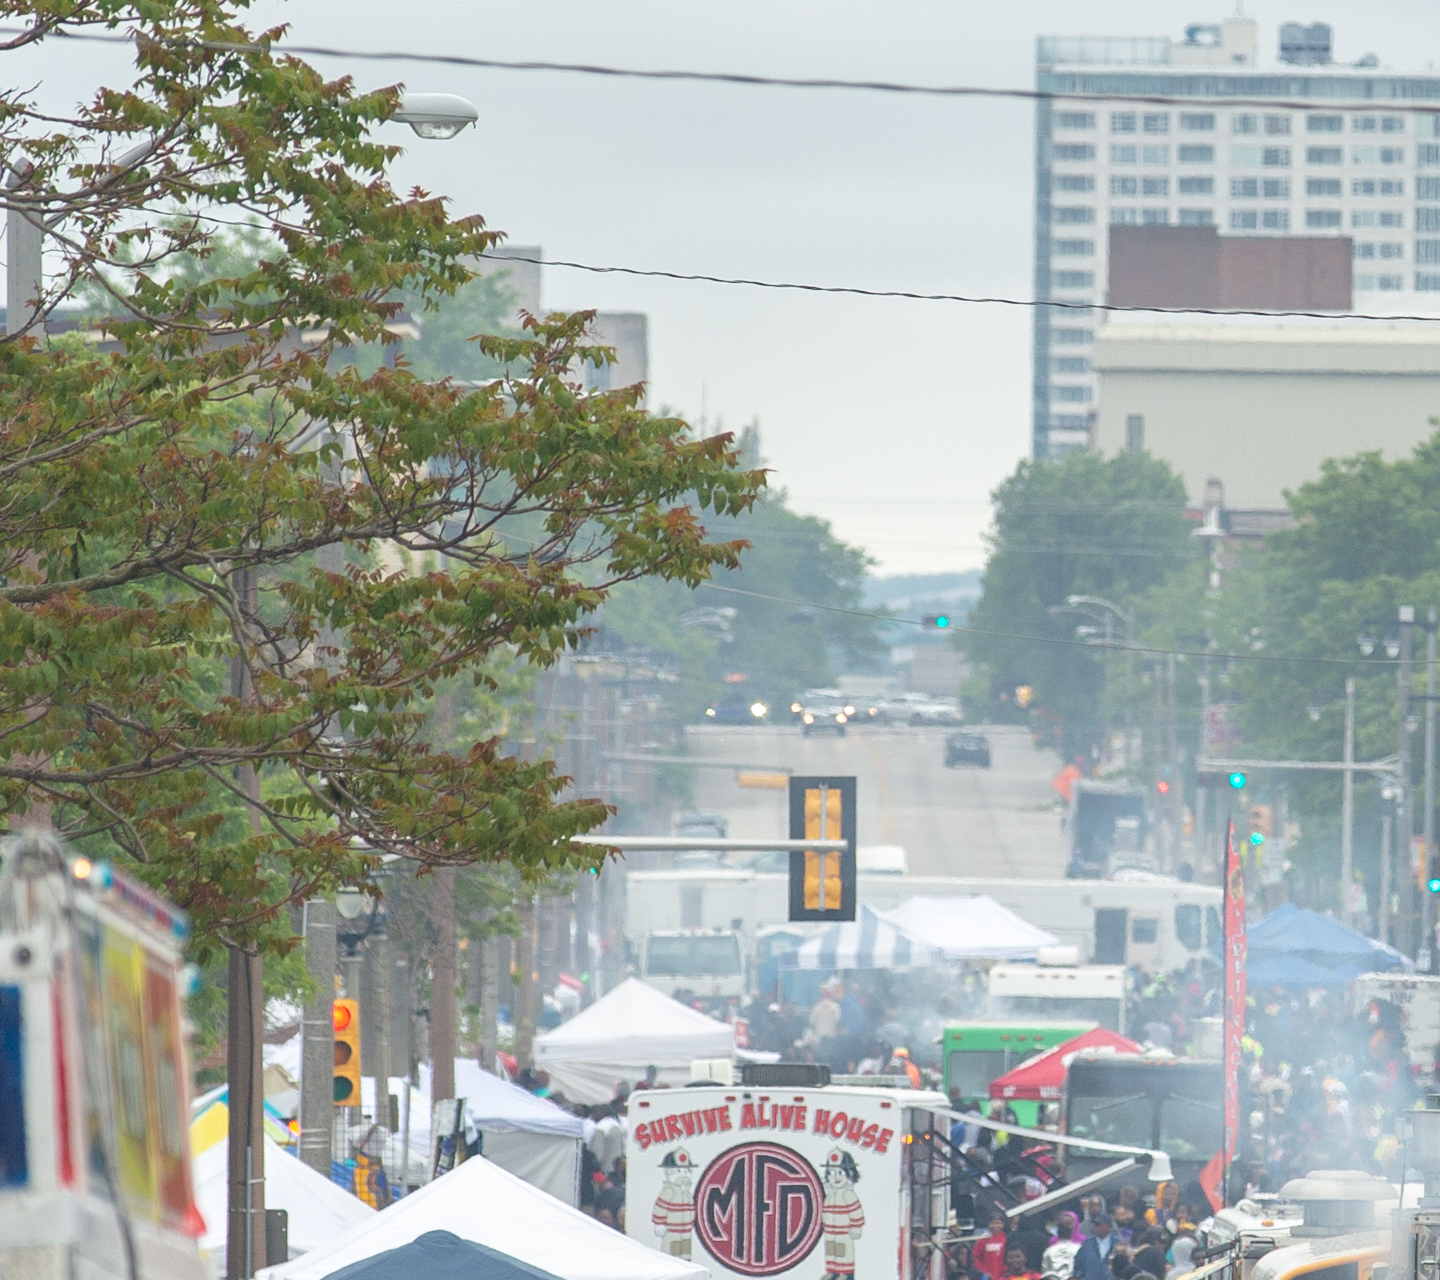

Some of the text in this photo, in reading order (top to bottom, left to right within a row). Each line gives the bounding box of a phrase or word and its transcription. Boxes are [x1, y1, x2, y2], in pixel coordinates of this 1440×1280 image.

[635, 1102, 894, 1154] SURVIVE ALIVE HOUSE
[706, 1153, 814, 1265] MFD
